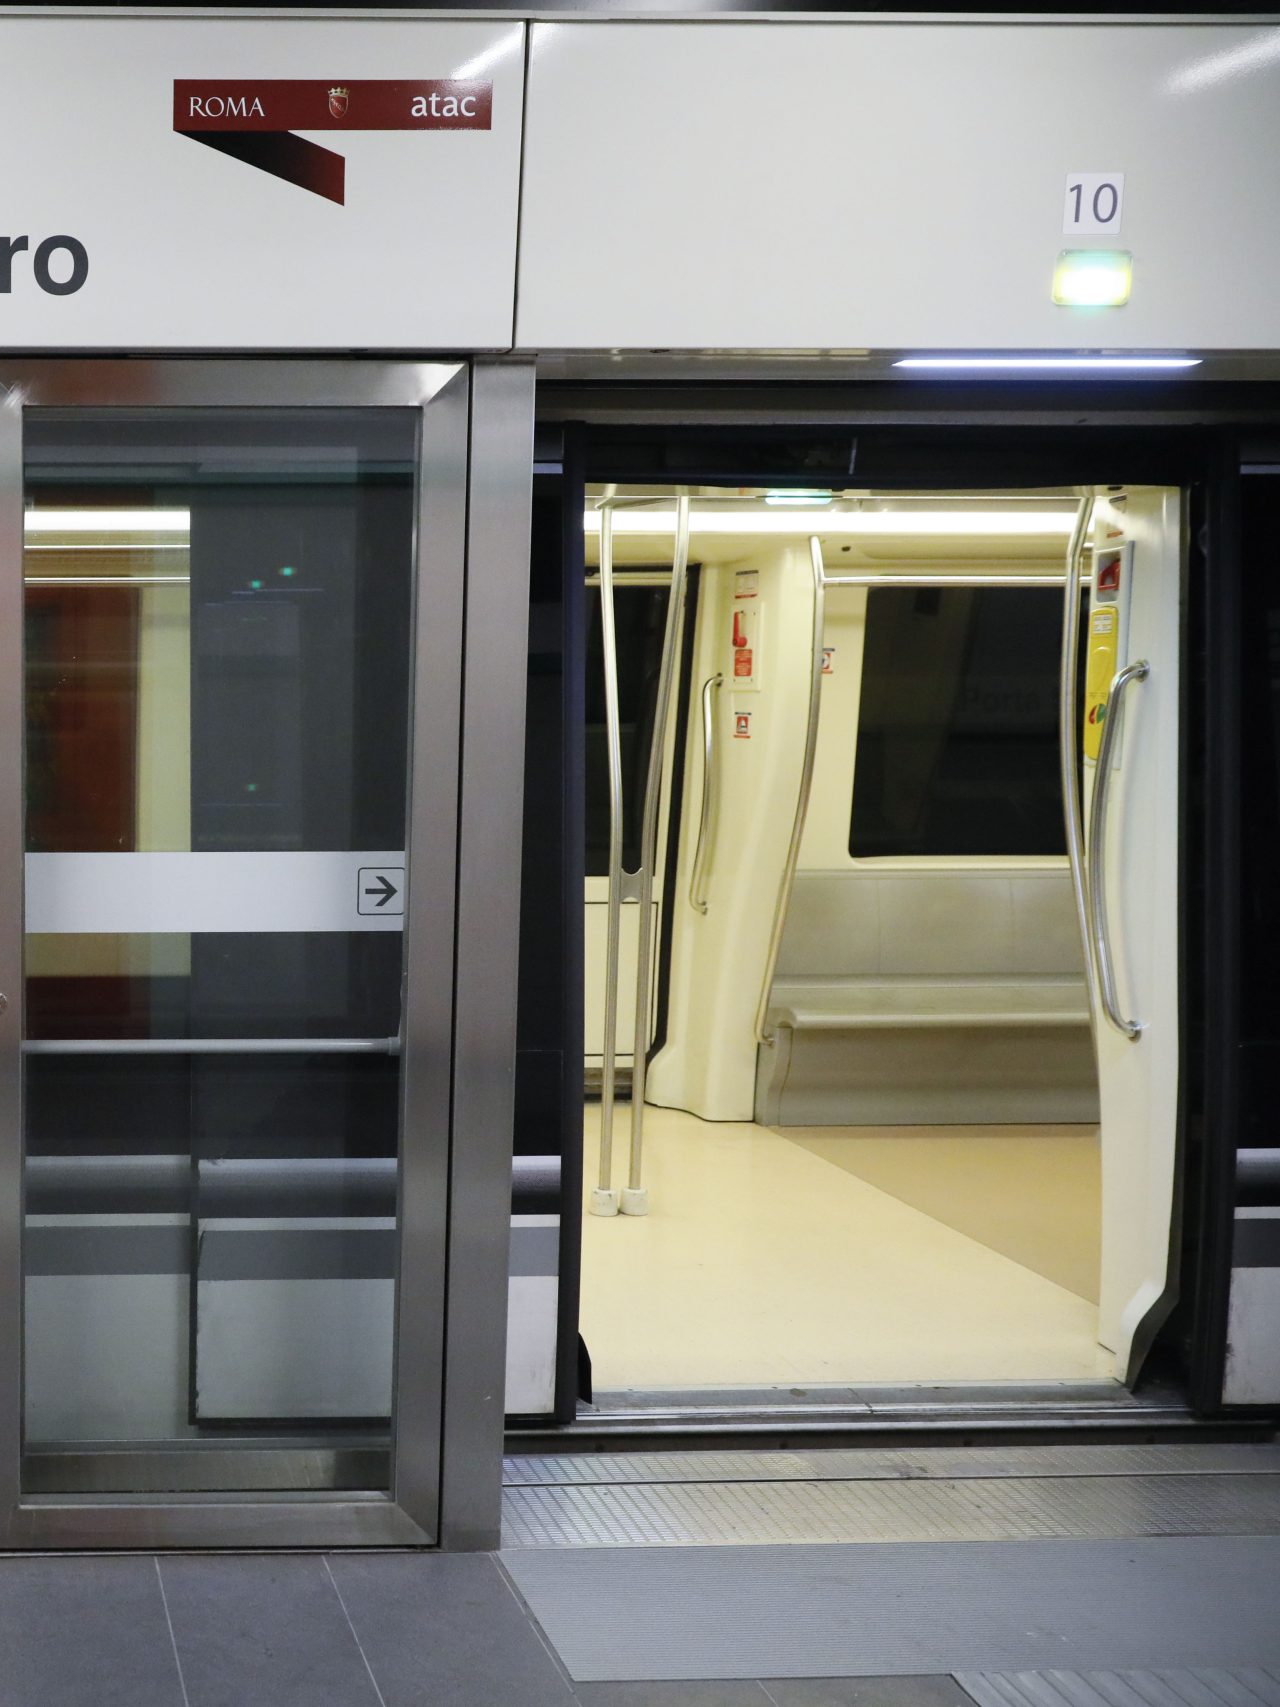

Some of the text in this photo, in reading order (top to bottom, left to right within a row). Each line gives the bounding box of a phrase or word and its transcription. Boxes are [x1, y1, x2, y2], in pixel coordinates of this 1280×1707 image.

[189, 96, 266, 117] ROMA
[410, 91, 477, 118] atac
[1069, 183, 1118, 223] 10
